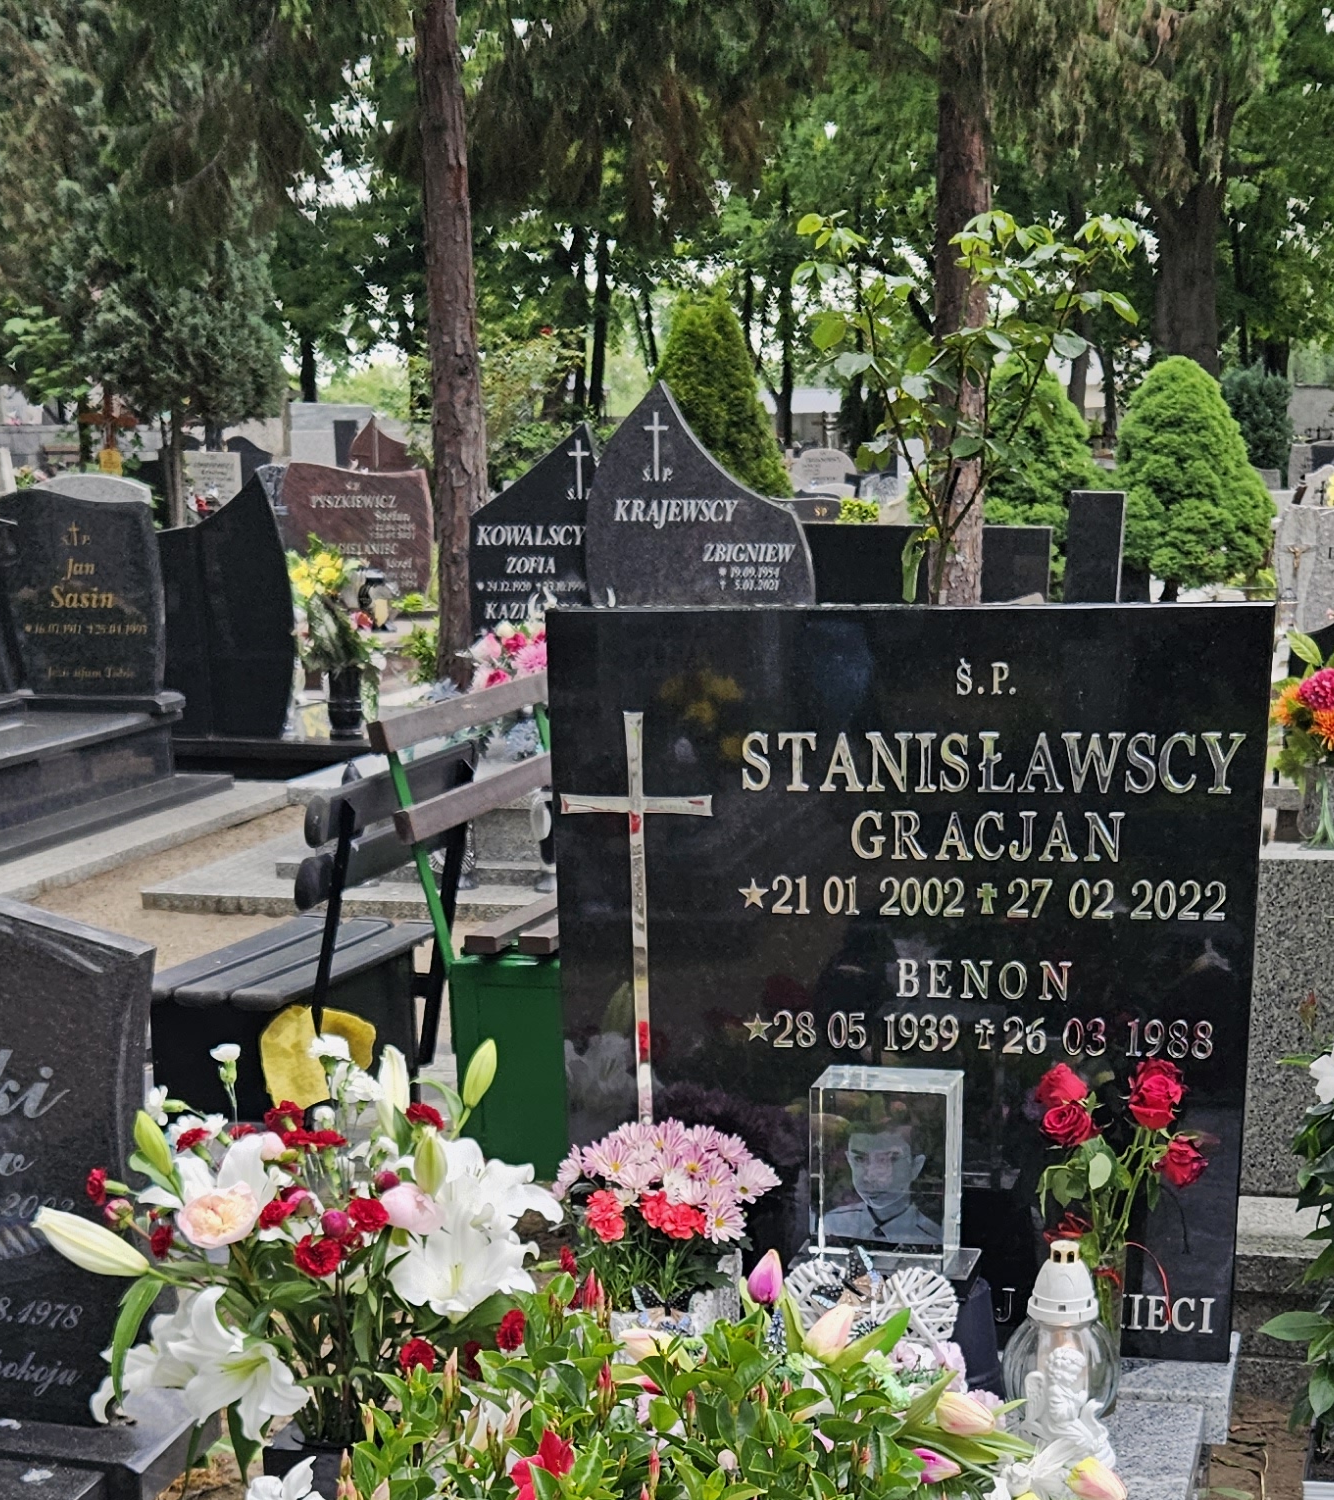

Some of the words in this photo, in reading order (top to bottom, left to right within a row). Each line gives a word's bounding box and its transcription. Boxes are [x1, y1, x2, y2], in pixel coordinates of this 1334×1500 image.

[614, 499, 739, 529] KRAJEWSCY
[476, 525, 586, 546] KOWALSCY
[506, 556, 555, 574] ZOFIA
[702, 543, 796, 563] ZBIGNIEW
[61, 557, 95, 581] Jan
[50, 585, 114, 609] Sasin
[741, 731, 1246, 794] STANISŁAWSCY
[851, 810, 1126, 862] GRACJAN
[771, 875, 811, 915] 21
[823, 875, 860, 916] 01
[879, 876, 965, 917] 2002
[1007, 878, 1053, 919] 27
[1068, 878, 1115, 920] 02
[1130, 879, 1227, 921] 2022
[896, 959, 1073, 1001] BENON
[773, 1010, 817, 1048] 28
[827, 1011, 867, 1050] 05
[883, 1012, 960, 1051] 1939
[1002, 1016, 1047, 1055] 26
[1062, 1017, 1107, 1057] 03
[1125, 1018, 1213, 1060] 1988
